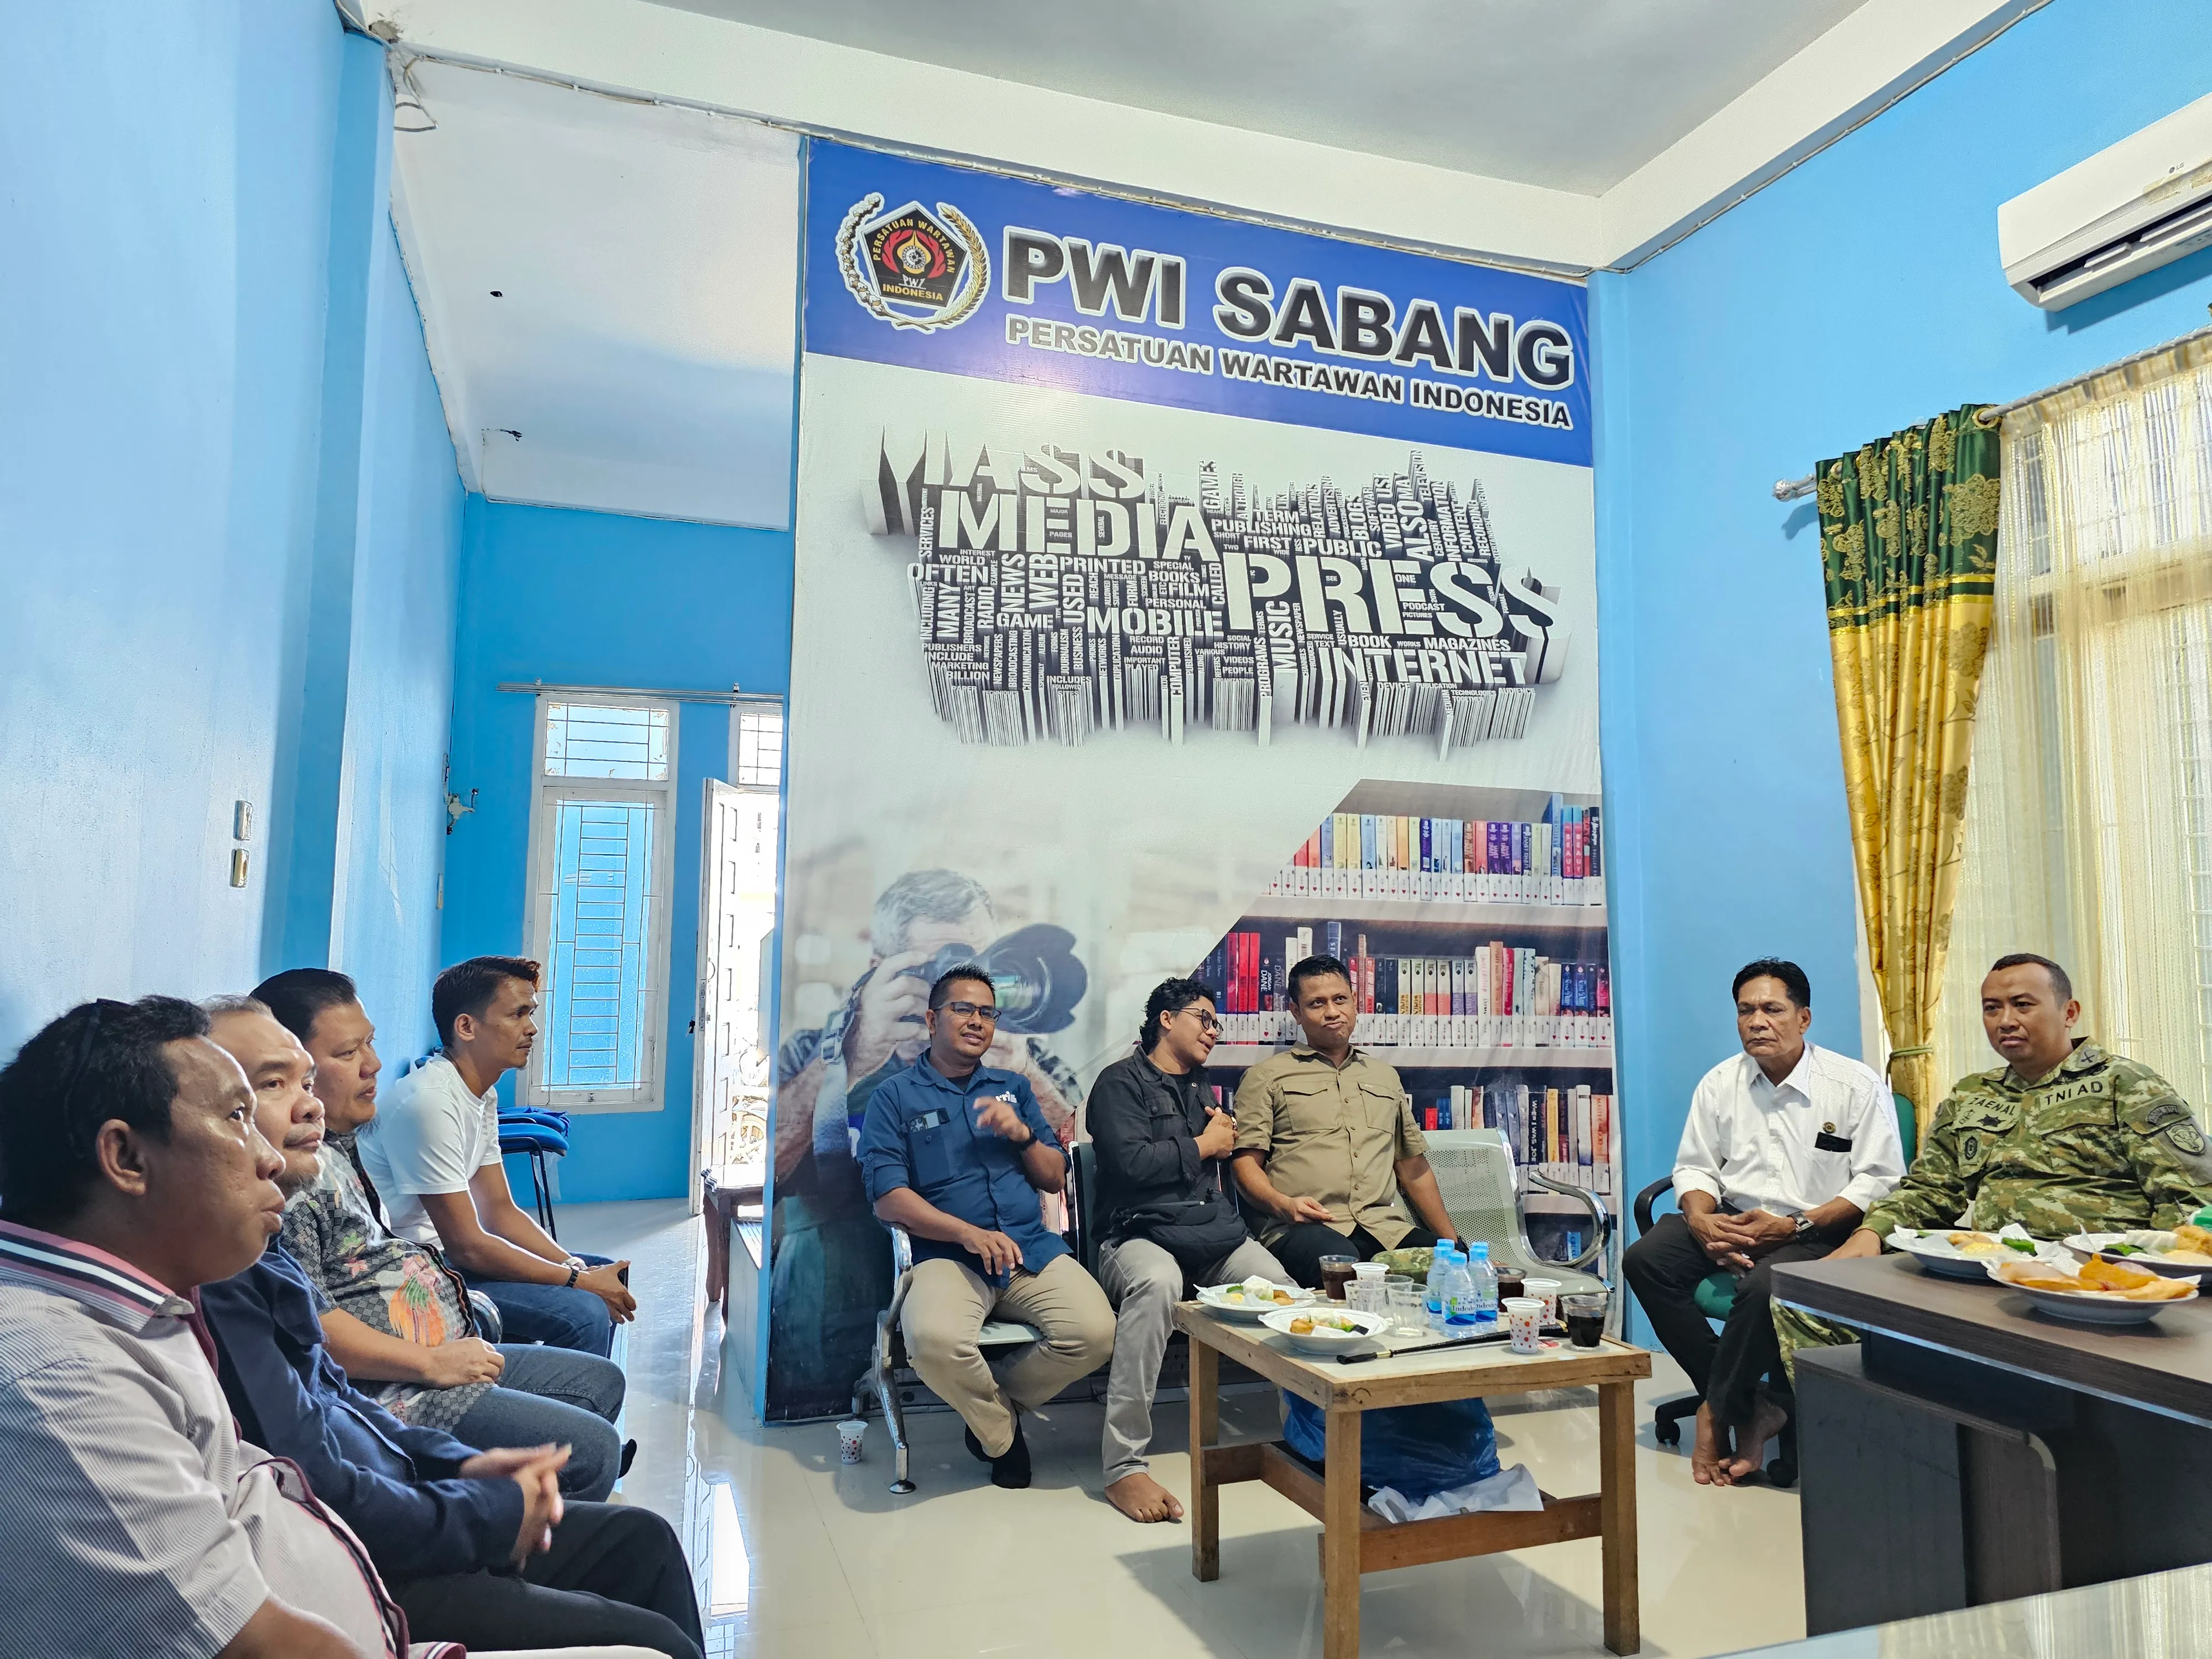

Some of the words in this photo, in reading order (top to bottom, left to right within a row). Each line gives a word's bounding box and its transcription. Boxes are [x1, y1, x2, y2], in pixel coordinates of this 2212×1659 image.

[873, 218, 913, 260] PERSATUAN
[918, 221, 954, 273] WARTAWAN
[883, 284, 943, 300] INDONESIA
[1004, 227, 1185, 327] PWI
[1214, 268, 1573, 389] SABANG
[1007, 315, 1213, 374] PERSATUAN
[1219, 349, 1404, 403] WARTAWAN
[1411, 379, 1572, 430] INDONESIA
[1199, 460, 1220, 509] GAMES
[1394, 472, 1413, 500] MAY
[1411, 450, 1433, 502] TELEVISION
[1233, 473, 1249, 520] ALTHOUGH
[1306, 483, 1326, 538] RELATIONS
[1321, 475, 1341, 534] ADVERTISING
[919, 507, 935, 558] SERVICES
[939, 490, 1220, 561] MEDIA
[1212, 519, 1312, 536] PUBLISHING
[1253, 509, 1300, 523] TERM
[1346, 495, 1370, 541] BLOGS
[1378, 503, 1403, 549] VIDEO
[1397, 500, 1434, 562] ALSO
[1431, 480, 1462, 562] INFORMATION
[1451, 501, 1475, 553] CONTENT
[1467, 500, 1491, 556] RECORDING
[1244, 535, 1292, 549] FIRST
[1294, 539, 1303, 551] RSS
[1303, 538, 1382, 557] PUBLIC
[1427, 519, 1444, 556] CENTURY
[1484, 518, 1501, 563] ENTERTAINMENT
[907, 562, 988, 583] OFTEN
[939, 555, 985, 565] WORLD
[1060, 556, 1146, 575] PRINTED
[1149, 571, 1200, 583] BOOKS
[1153, 561, 1194, 570] SPECIAL
[1001, 553, 1025, 613] NEWS
[1029, 554, 1058, 609] WEB
[1088, 572, 1099, 599] REACH
[1126, 580, 1138, 607] FORM
[1159, 582, 1167, 594] ETC
[1168, 583, 1209, 597] FILM
[1209, 562, 1225, 604] CALLED
[1223, 552, 1565, 639] PRESS
[1395, 575, 1416, 583] ONE
[920, 587, 935, 640] INCLUDING
[937, 582, 961, 637] MANY
[977, 586, 995, 628] RADIO
[1062, 574, 1086, 623] USED
[1145, 598, 1207, 609] PERSONAL
[1499, 593, 1509, 613] FORMAT
[963, 591, 975, 644] BROADCAST
[997, 613, 1053, 628] GAME
[1087, 607, 1224, 637] MOBILE
[1256, 611, 1266, 634] TERMS
[1292, 602, 1305, 643] NEWSPAPER
[1333, 610, 1347, 645] USUALLY
[922, 643, 982, 651] PUBLISHERS
[1060, 629, 1069, 675] JOURNALISM
[1072, 626, 1083, 670] BUSINESS
[1130, 645, 1163, 654] AUDIO
[1265, 601, 1298, 672] MUSIC
[1348, 635, 1392, 648] BOOK
[1423, 637, 1511, 651] MAGAZINES
[925, 651, 974, 661] INCLUDE
[932, 661, 989, 670] MARKETING
[993, 634, 1003, 685] NEWSPAPERS
[1009, 630, 1018, 688] BROADCASTING
[1022, 629, 1031, 691] COMMUNICATION
[1098, 638, 1107, 677] NETWORKS
[1112, 634, 1121, 681] DUPLICATION
[1167, 637, 1183, 696] COMPUTER
[1183, 638, 1193, 676] PUBLISHED
[1214, 656, 1222, 677] REFERS
[1254, 637, 1272, 696] PROGRAMS
[1300, 648, 1309, 677] CHANNELS
[1307, 641, 1317, 670] PRODUCED
[1318, 648, 1527, 685] INTERNET
[947, 671, 990, 680] BILLION
[1359, 682, 1371, 702] EVEN
[1442, 690, 1453, 716] MEDIUM
[1968, 1097, 2016, 1116] ZAENAL
[2045, 1088, 2072, 1105] TNI
[2077, 1081, 2103, 1095] AD
